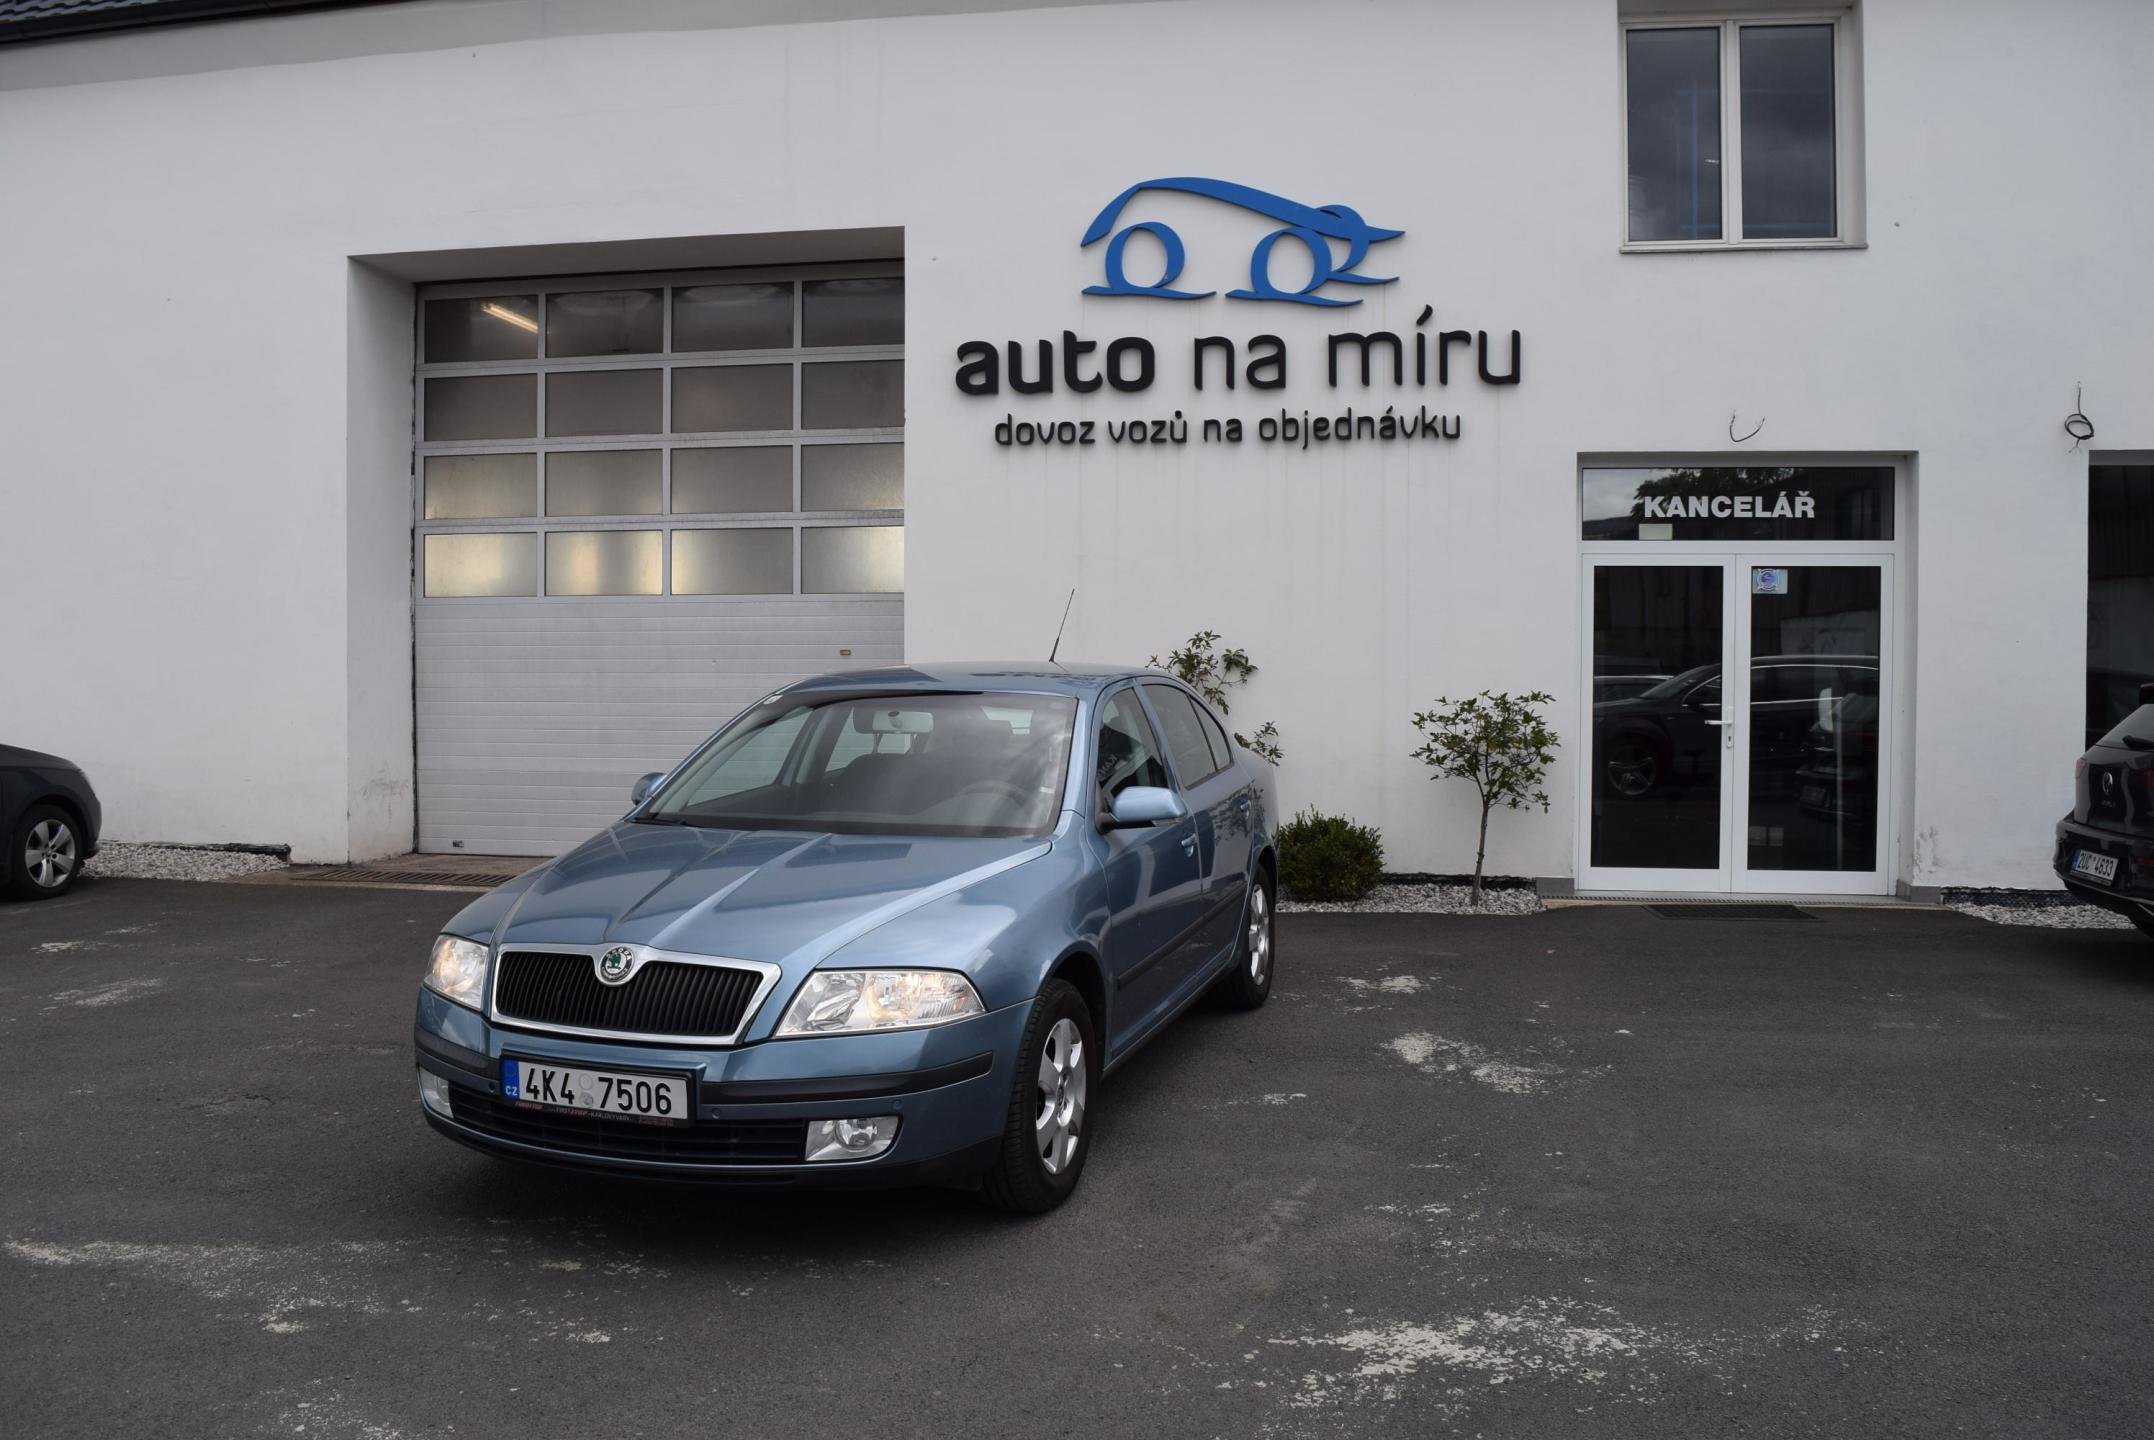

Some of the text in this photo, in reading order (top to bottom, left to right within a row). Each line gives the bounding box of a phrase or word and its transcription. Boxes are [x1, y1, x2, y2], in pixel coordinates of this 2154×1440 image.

[955, 304, 1521, 396] auto na míru
[995, 405, 1461, 450] dovoz vozů na objednávku
[1644, 491, 1815, 518] KANCELÁŘ
[505, 1086, 518, 1096] CZ
[525, 1067, 672, 1115] 4K4 7506
